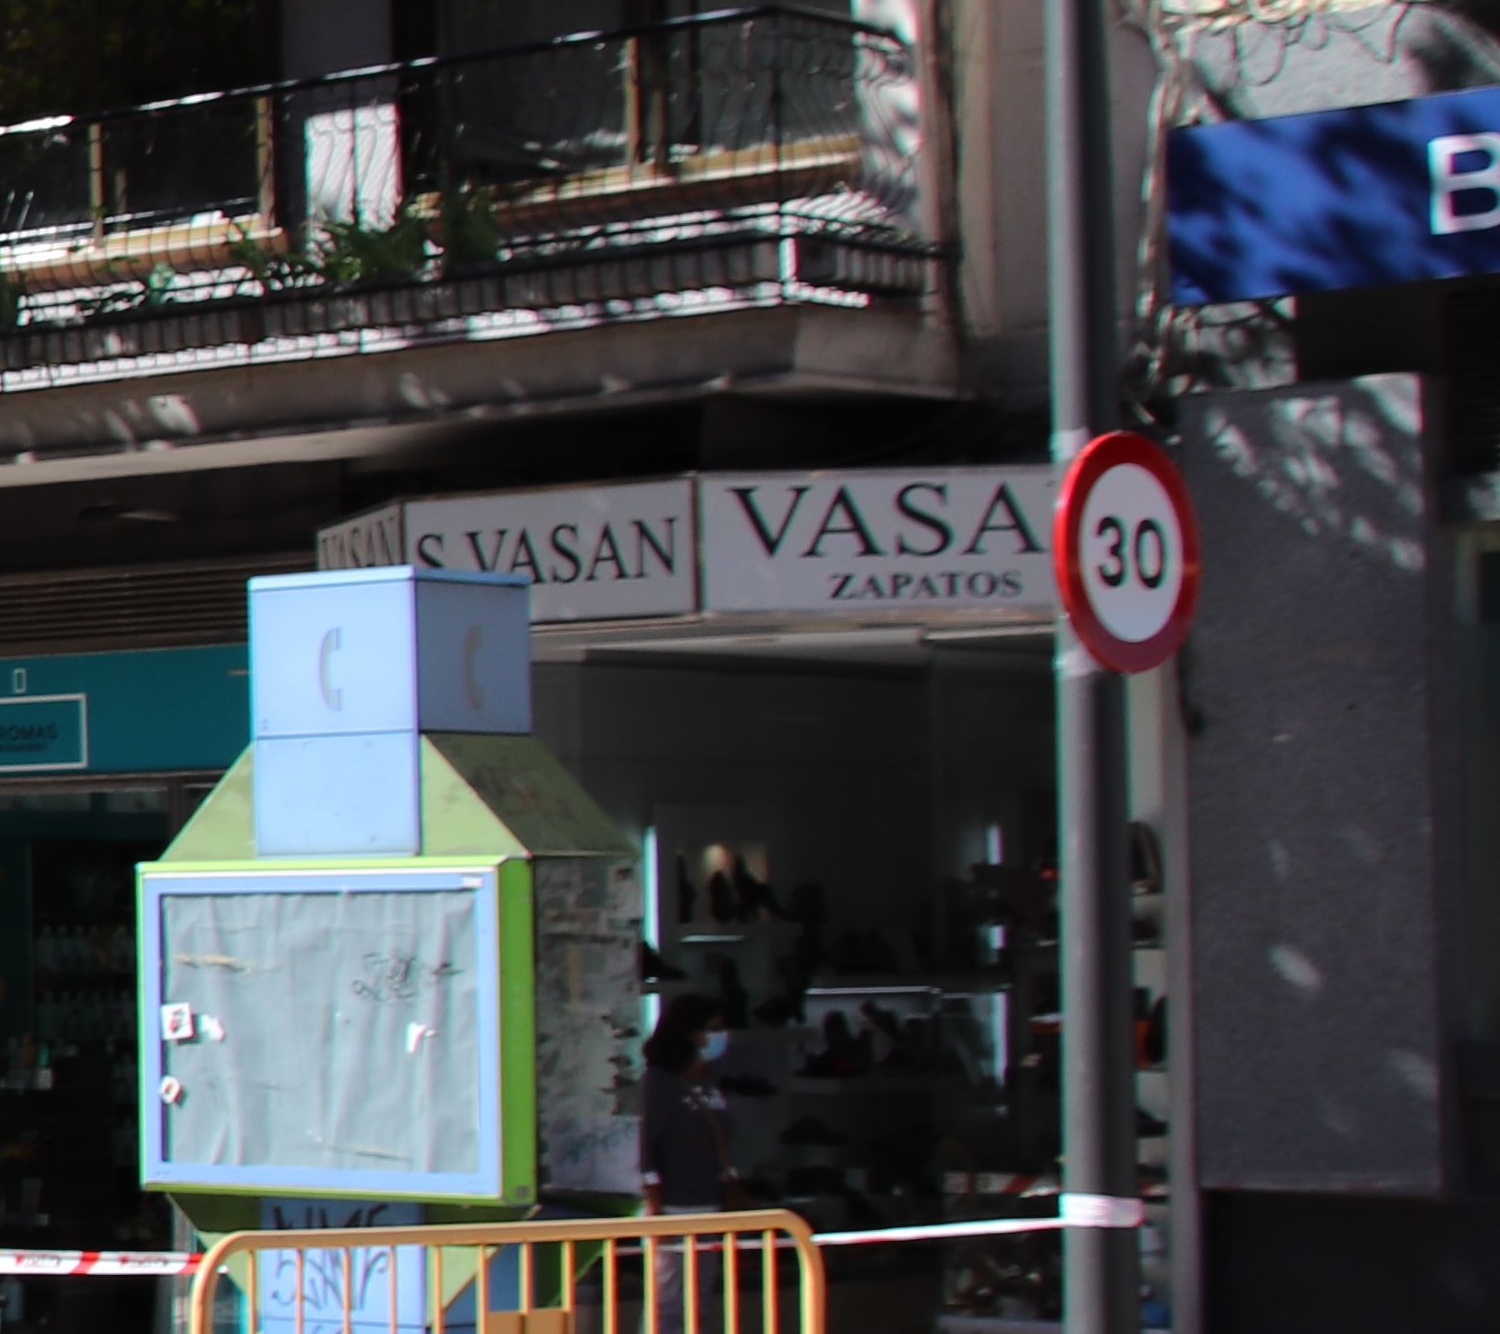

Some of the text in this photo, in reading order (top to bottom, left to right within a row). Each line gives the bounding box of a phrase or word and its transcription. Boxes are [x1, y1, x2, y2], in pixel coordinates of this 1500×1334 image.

[465, 516, 678, 585] VASAN
[726, 480, 1058, 558] VASA
[1097, 516, 1166, 590] 30
[829, 571, 1023, 602] ZAPATOS
